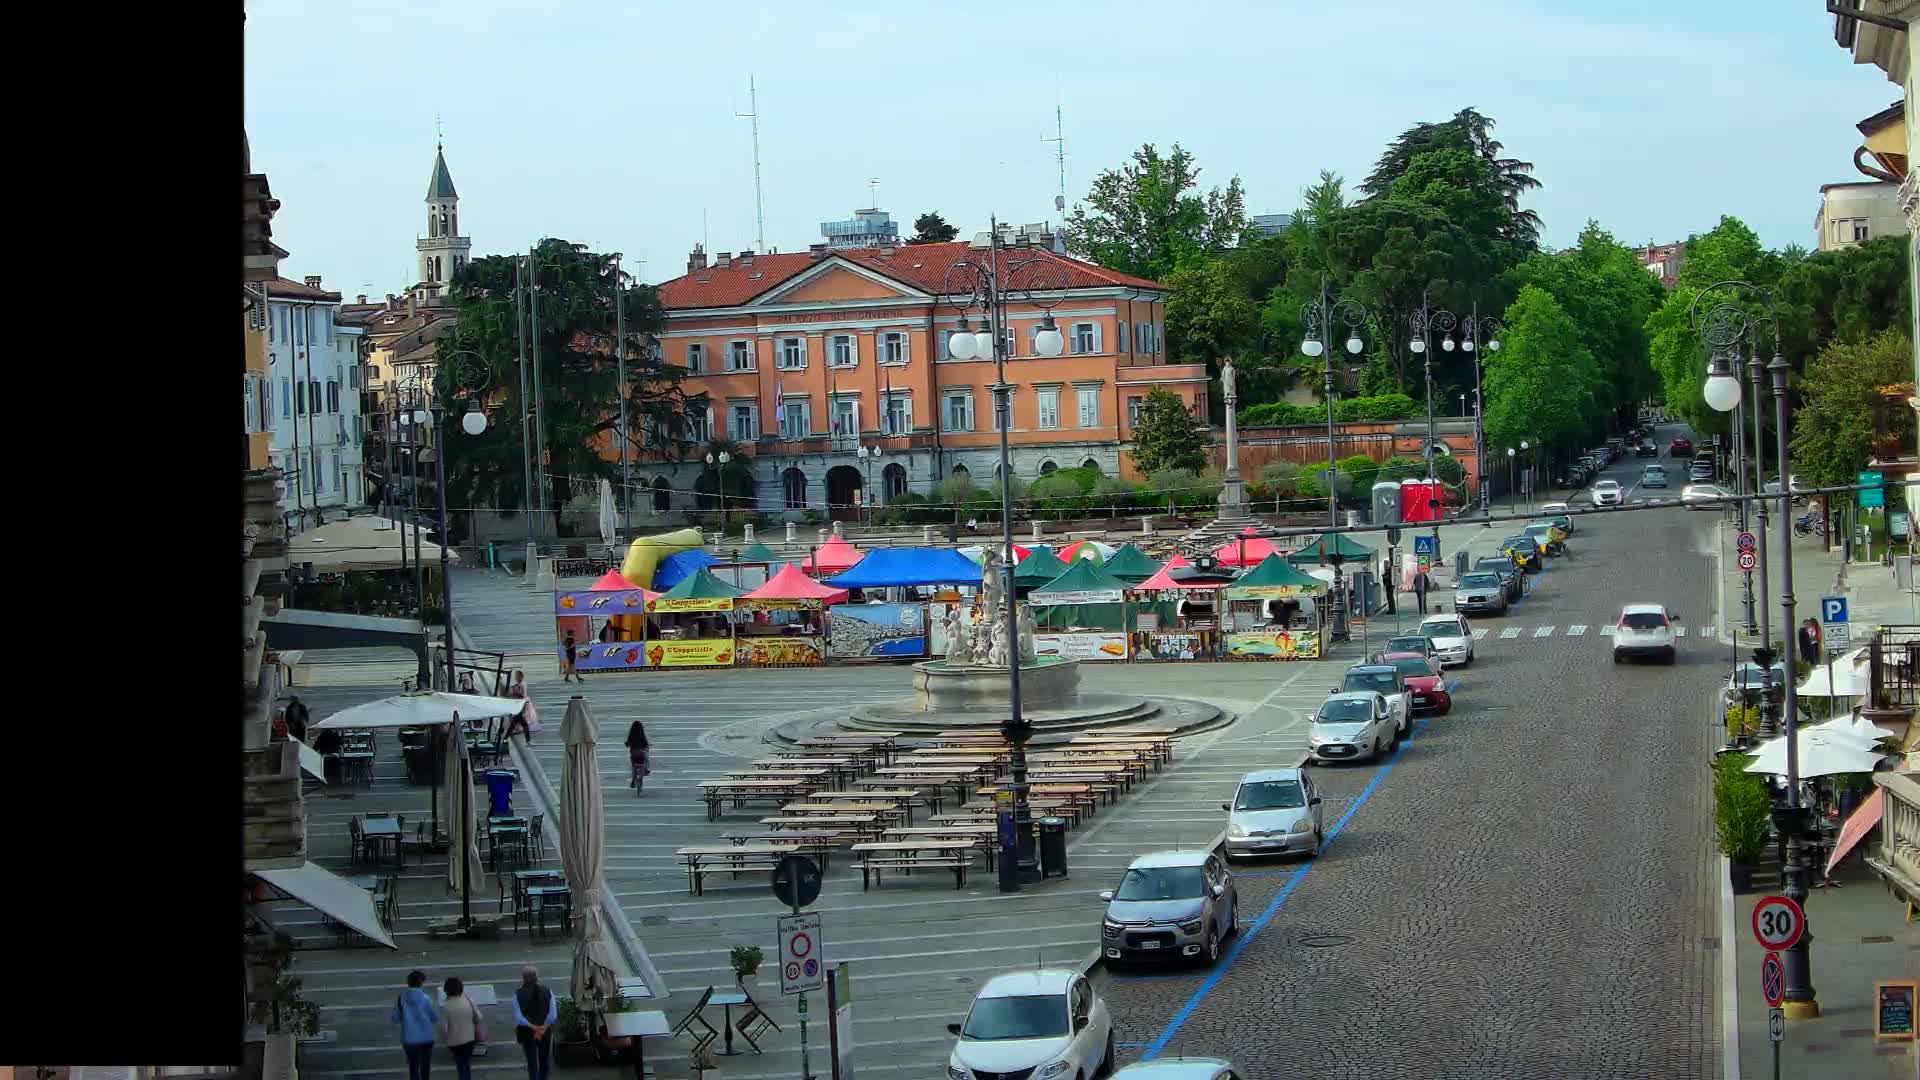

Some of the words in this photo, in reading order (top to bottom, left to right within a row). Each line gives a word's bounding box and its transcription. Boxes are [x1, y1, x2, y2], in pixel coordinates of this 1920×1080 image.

[1743, 557, 1752, 565] 20
[1827, 601, 1841, 620] P
[1761, 910, 1791, 936] 30
